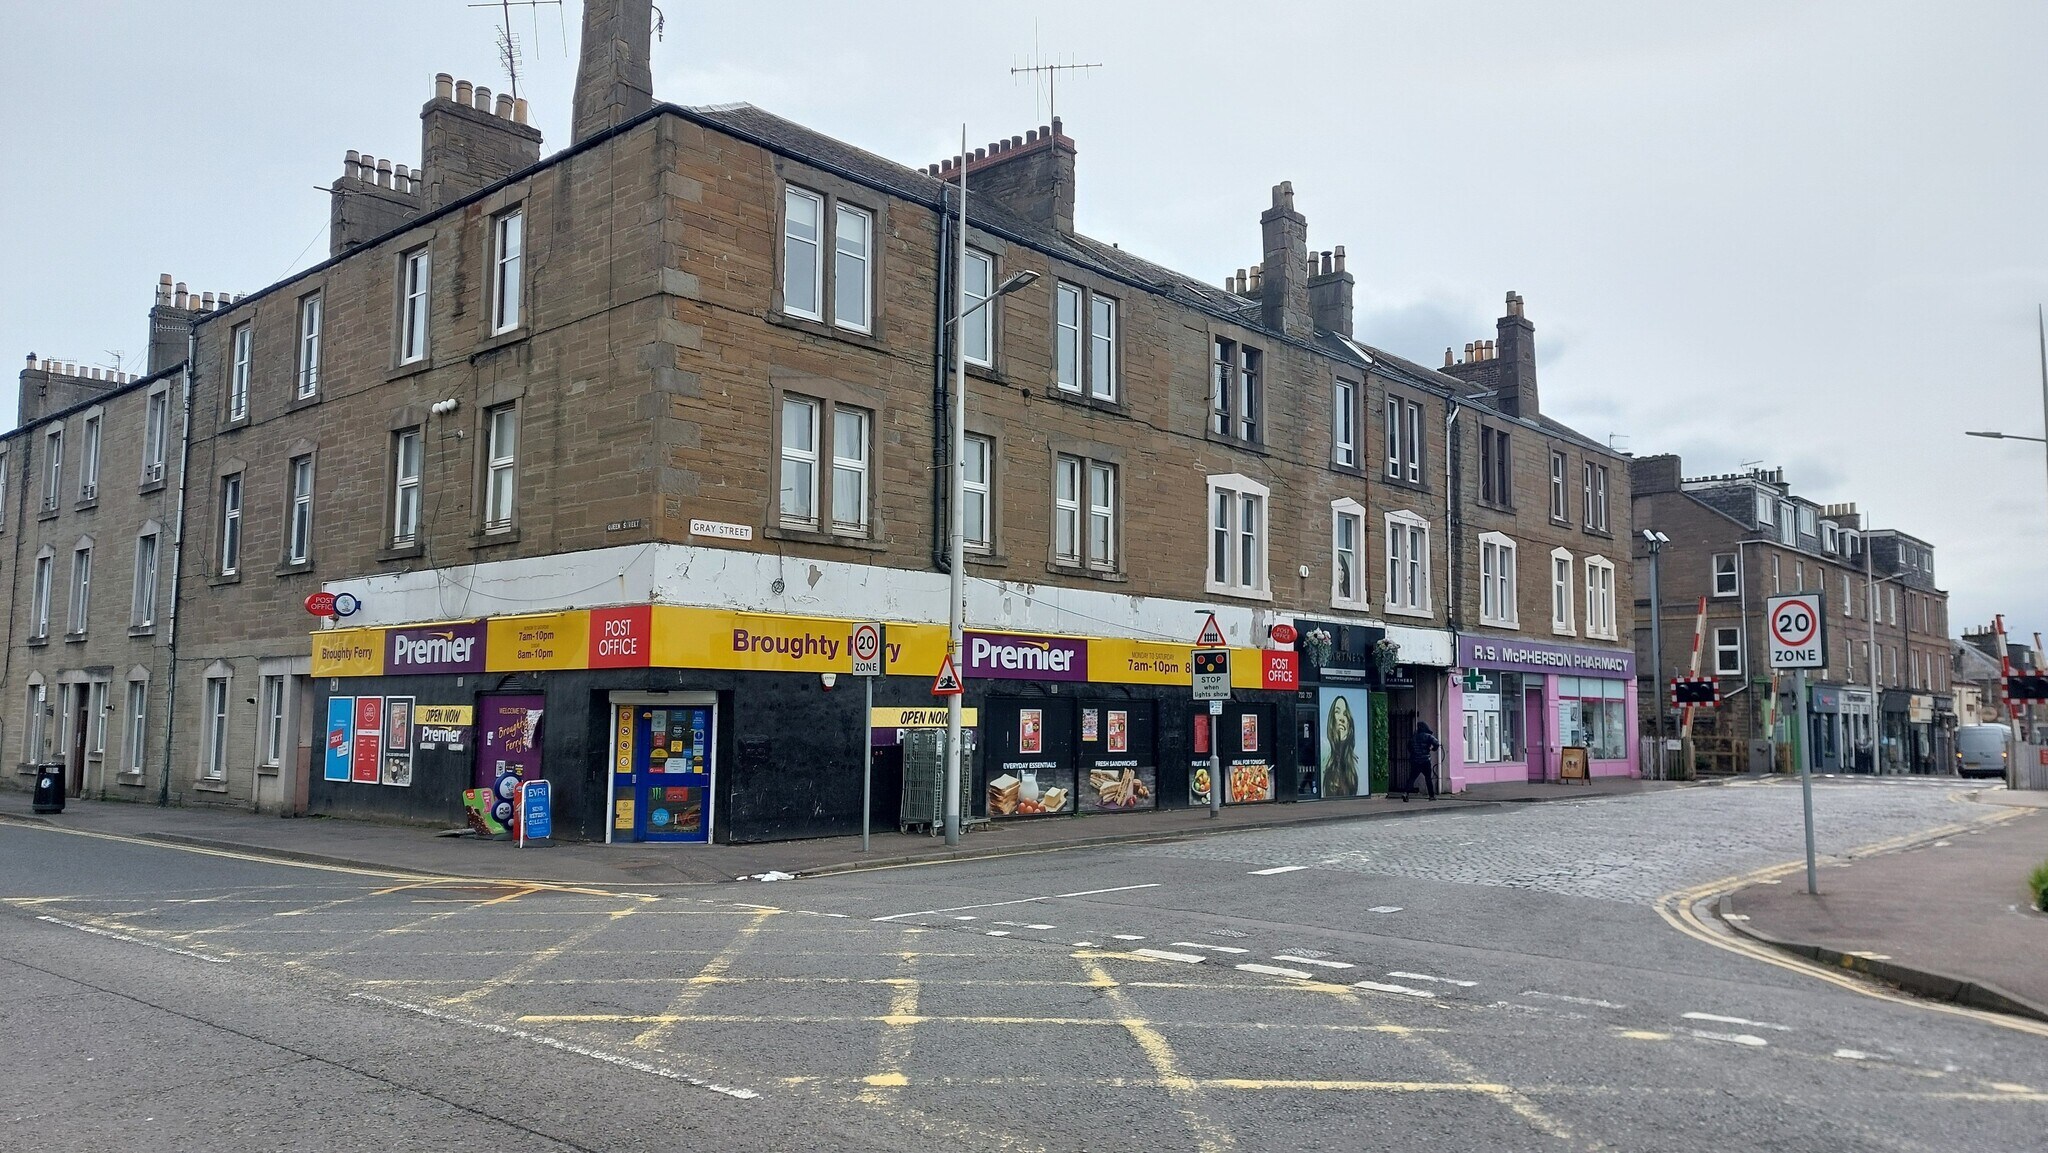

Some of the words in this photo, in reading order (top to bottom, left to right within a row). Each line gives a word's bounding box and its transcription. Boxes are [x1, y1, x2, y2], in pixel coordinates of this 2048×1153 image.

[607, 523, 621, 531] QUEEN
[693, 522, 717, 533] GRAY
[719, 525, 750, 538] STREET
[605, 620, 631, 637] POST
[1779, 613, 1810, 633] 20
[518, 630, 554, 642] 7am-10pm
[858, 635, 875, 650] 20
[394, 632, 475, 665] Premier
[598, 638, 637, 656] OFFICE
[733, 628, 839, 660] Broughty
[321, 647, 352, 661] Broughty
[353, 646, 373, 660] Ferry
[517, 648, 553, 660] 8am-10pm
[972, 638, 1074, 671] Premier
[1474, 645, 1499, 661] R.S.
[1502, 647, 1572, 667] McPHERSON
[1574, 655, 1629, 672] PHARMACY
[1775, 649, 1817, 662] ZONE
[855, 662, 877, 671] ZONE
[1128, 659, 1179, 674] 7am-10pm
[1271, 658, 1289, 670] POST
[1268, 670, 1293, 682] OFFICE
[425, 709, 442, 722] OPEN
[443, 709, 461, 723] NOW
[900, 711, 926, 724] OPEN
[422, 726, 461, 742] Premier
[505, 737, 522, 753] Ferry
